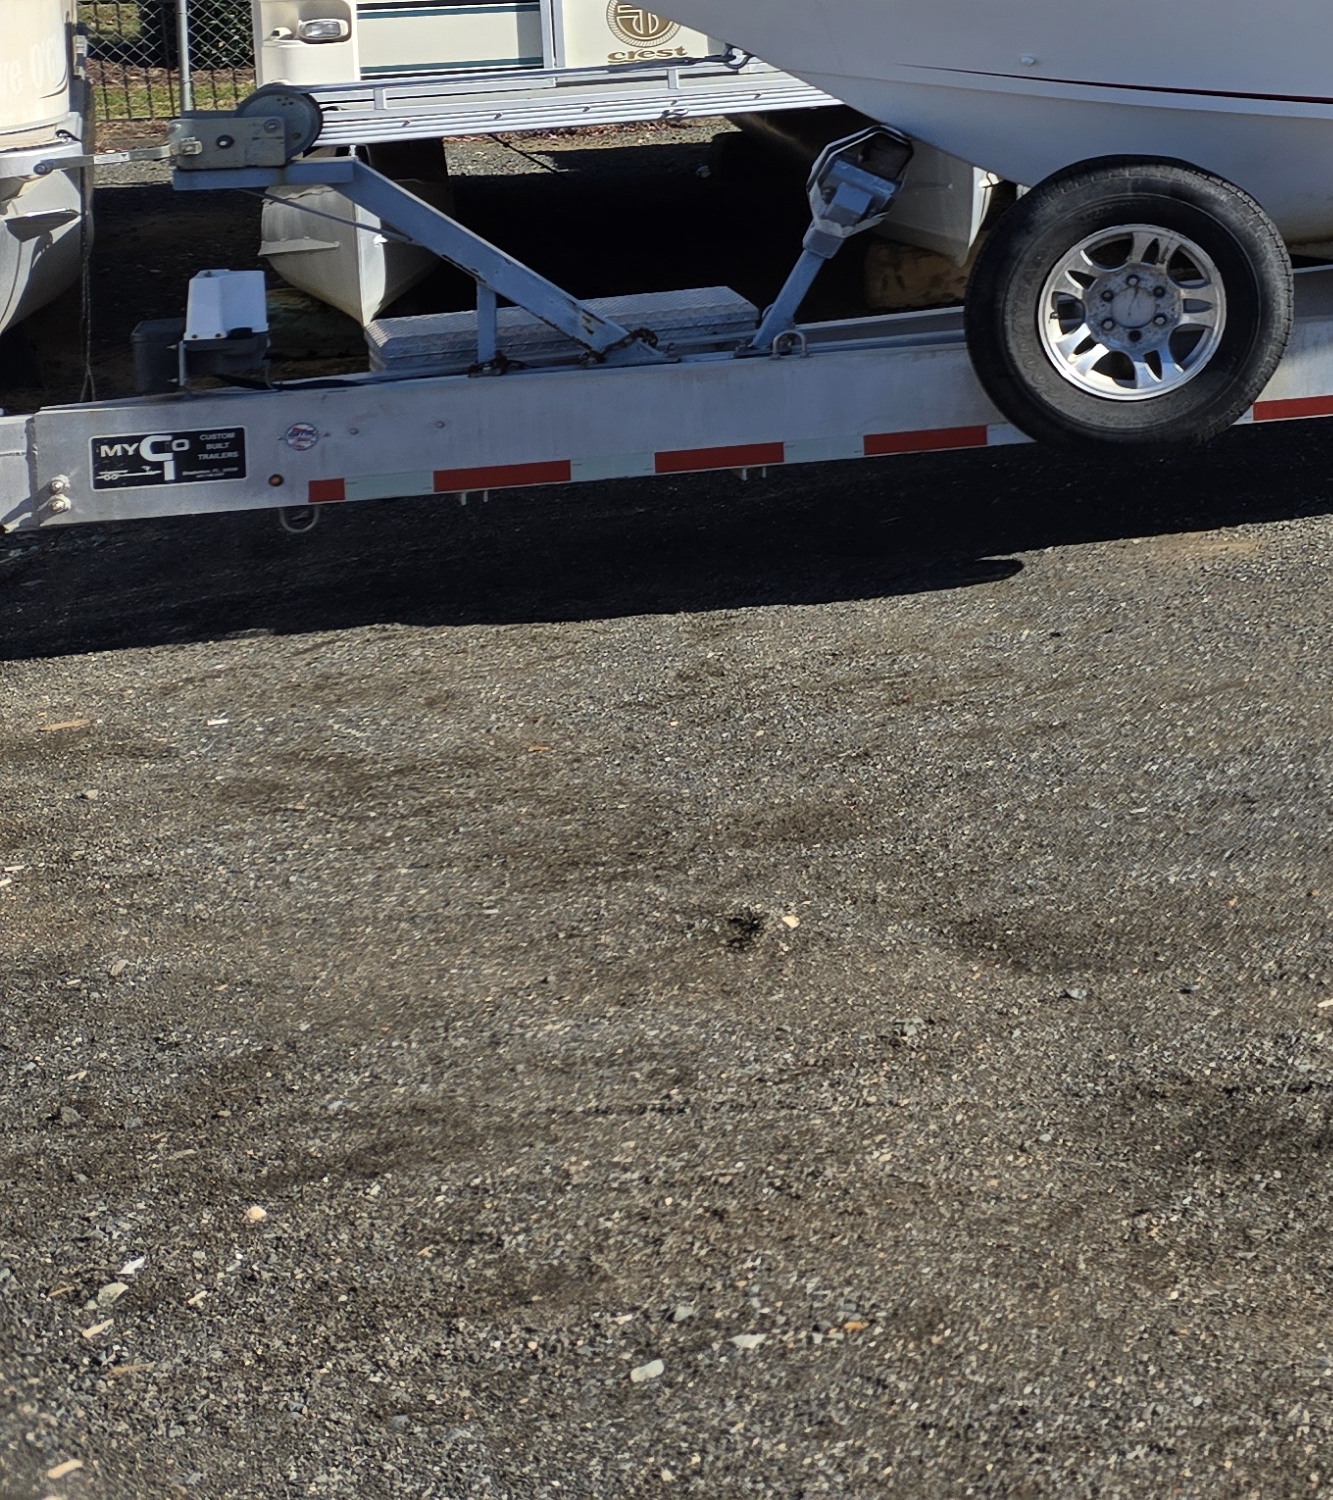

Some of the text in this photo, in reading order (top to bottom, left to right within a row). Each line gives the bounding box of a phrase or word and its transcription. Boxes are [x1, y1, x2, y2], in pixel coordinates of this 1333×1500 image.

[607, 45, 688, 61] crest
[199, 432, 236, 442] CUSTOM
[205, 442, 230, 451] BUILT
[198, 451, 239, 461] TRAILERS
